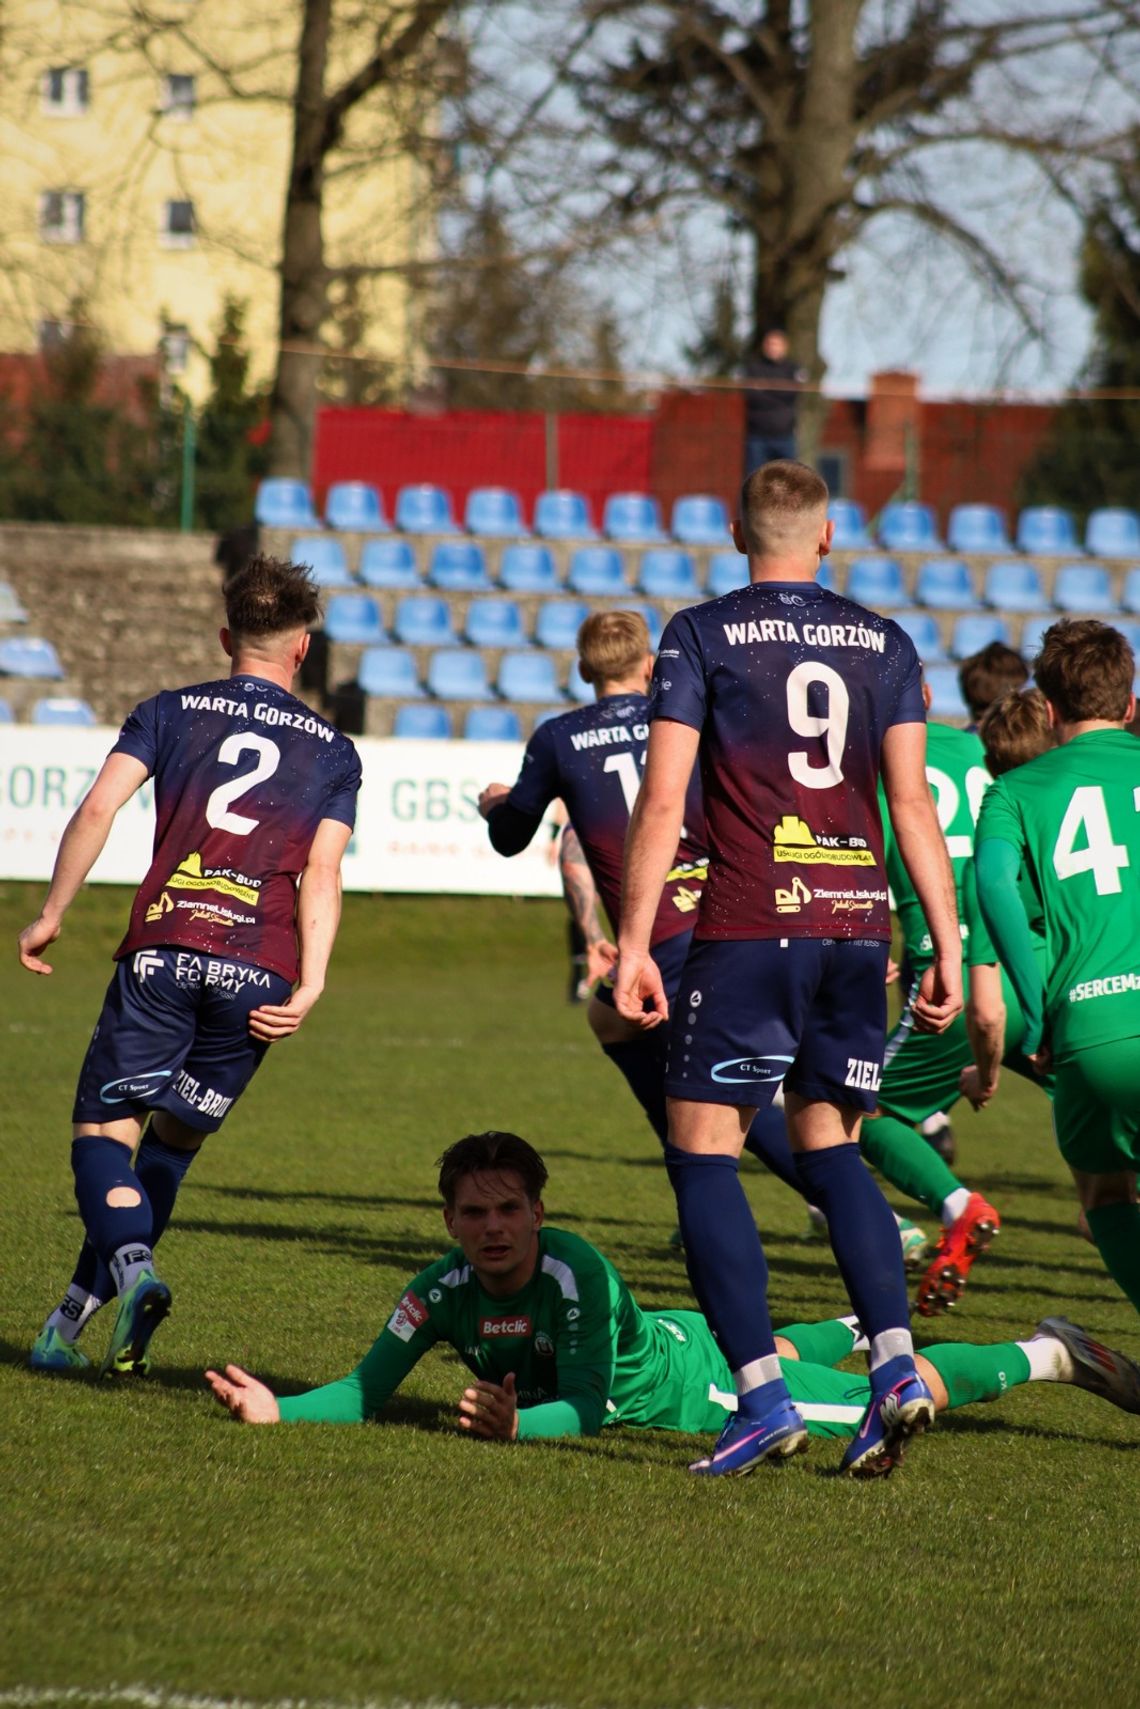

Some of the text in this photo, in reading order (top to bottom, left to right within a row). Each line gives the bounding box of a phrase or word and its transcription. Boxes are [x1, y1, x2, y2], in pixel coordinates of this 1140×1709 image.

[723, 619, 886, 653] WARTA GORZÓW
[181, 695, 335, 743] WARTA GORZÓW
[786, 661, 849, 789] 9
[570, 725, 631, 751] WARTA
[205, 731, 281, 835] 2
[391, 778, 481, 822] GBS
[1053, 785, 1140, 896] 4
[204, 869, 262, 888] PAK-BUD
[740, 1063, 751, 1072] CT
[844, 1058, 882, 1092] ZIEL
[118, 1084, 128, 1092] CT
[483, 1320, 528, 1334] Betclic
